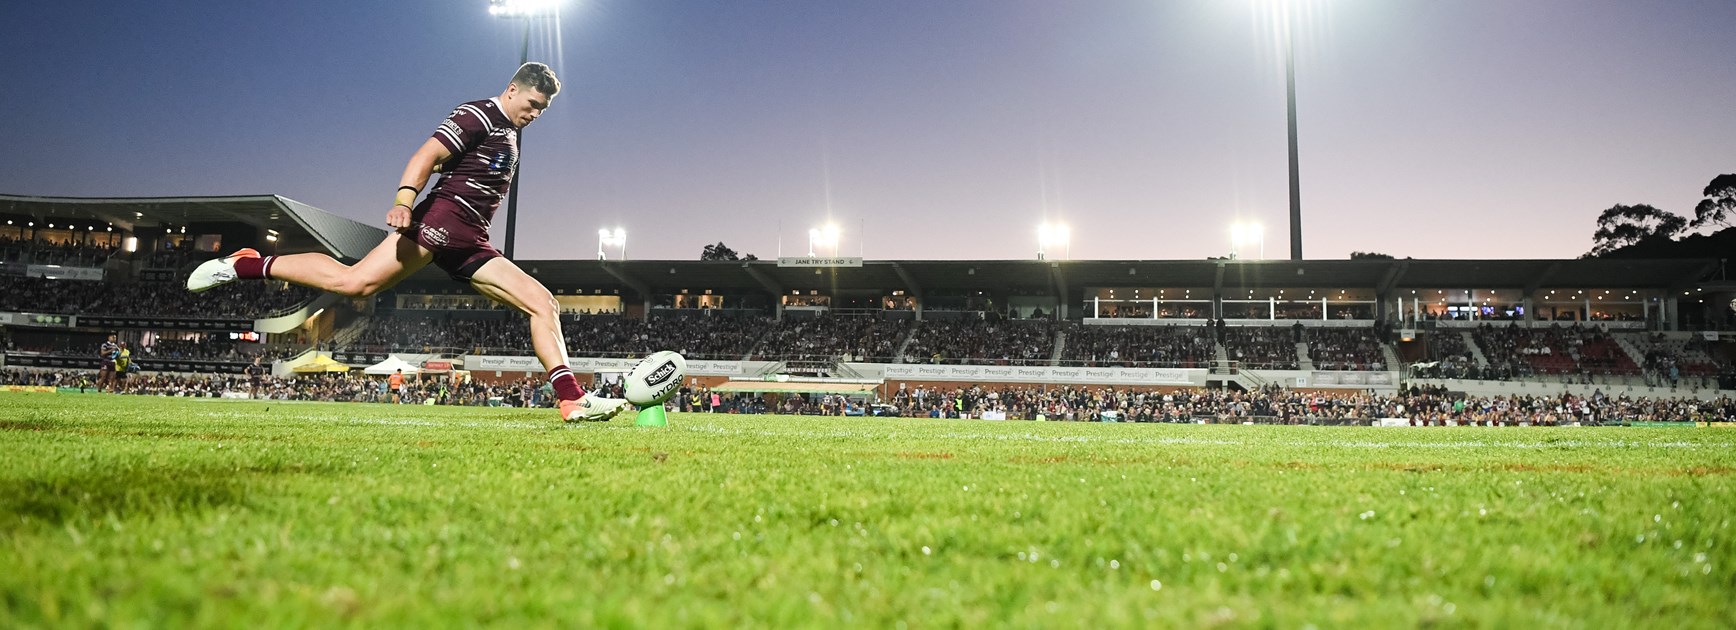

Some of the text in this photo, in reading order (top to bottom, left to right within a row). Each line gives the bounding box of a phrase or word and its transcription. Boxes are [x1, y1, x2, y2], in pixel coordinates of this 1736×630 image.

[569, 360, 589, 368] restige
[713, 364, 738, 372] Prestige
[647, 363, 676, 385] Schick
[886, 367, 912, 375] Prestige
[919, 367, 945, 375] Prestige
[952, 368, 978, 376] Prestige
[985, 368, 1011, 376] Prestige
[1018, 369, 1045, 377] Prestige
[1086, 370, 1113, 378] Prestige
[652, 374, 684, 400] HYDRO
